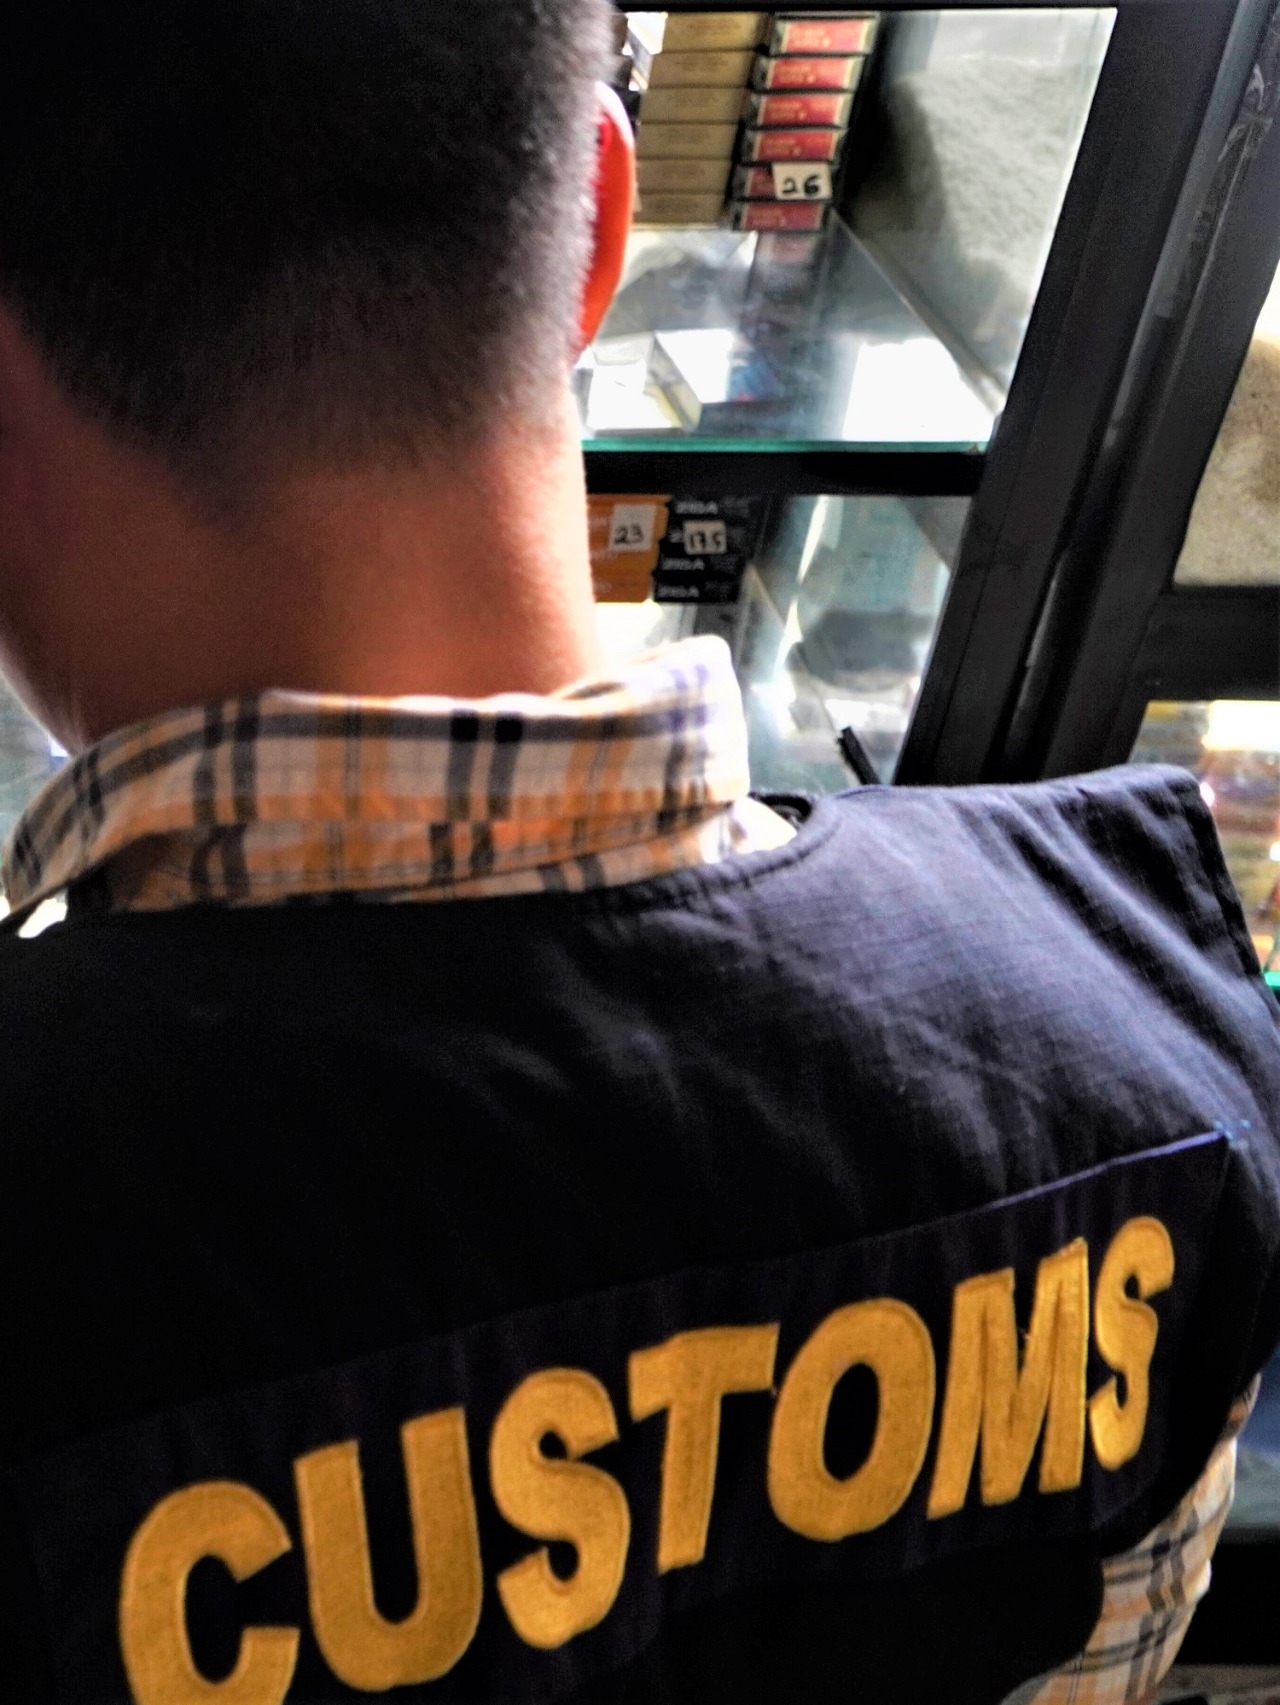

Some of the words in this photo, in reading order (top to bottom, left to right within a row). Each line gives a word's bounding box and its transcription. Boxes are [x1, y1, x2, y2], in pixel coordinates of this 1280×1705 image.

[782, 174, 820, 196] 26
[614, 522, 645, 545] 23
[122, 1216, 1175, 1705] CUSTOMS
